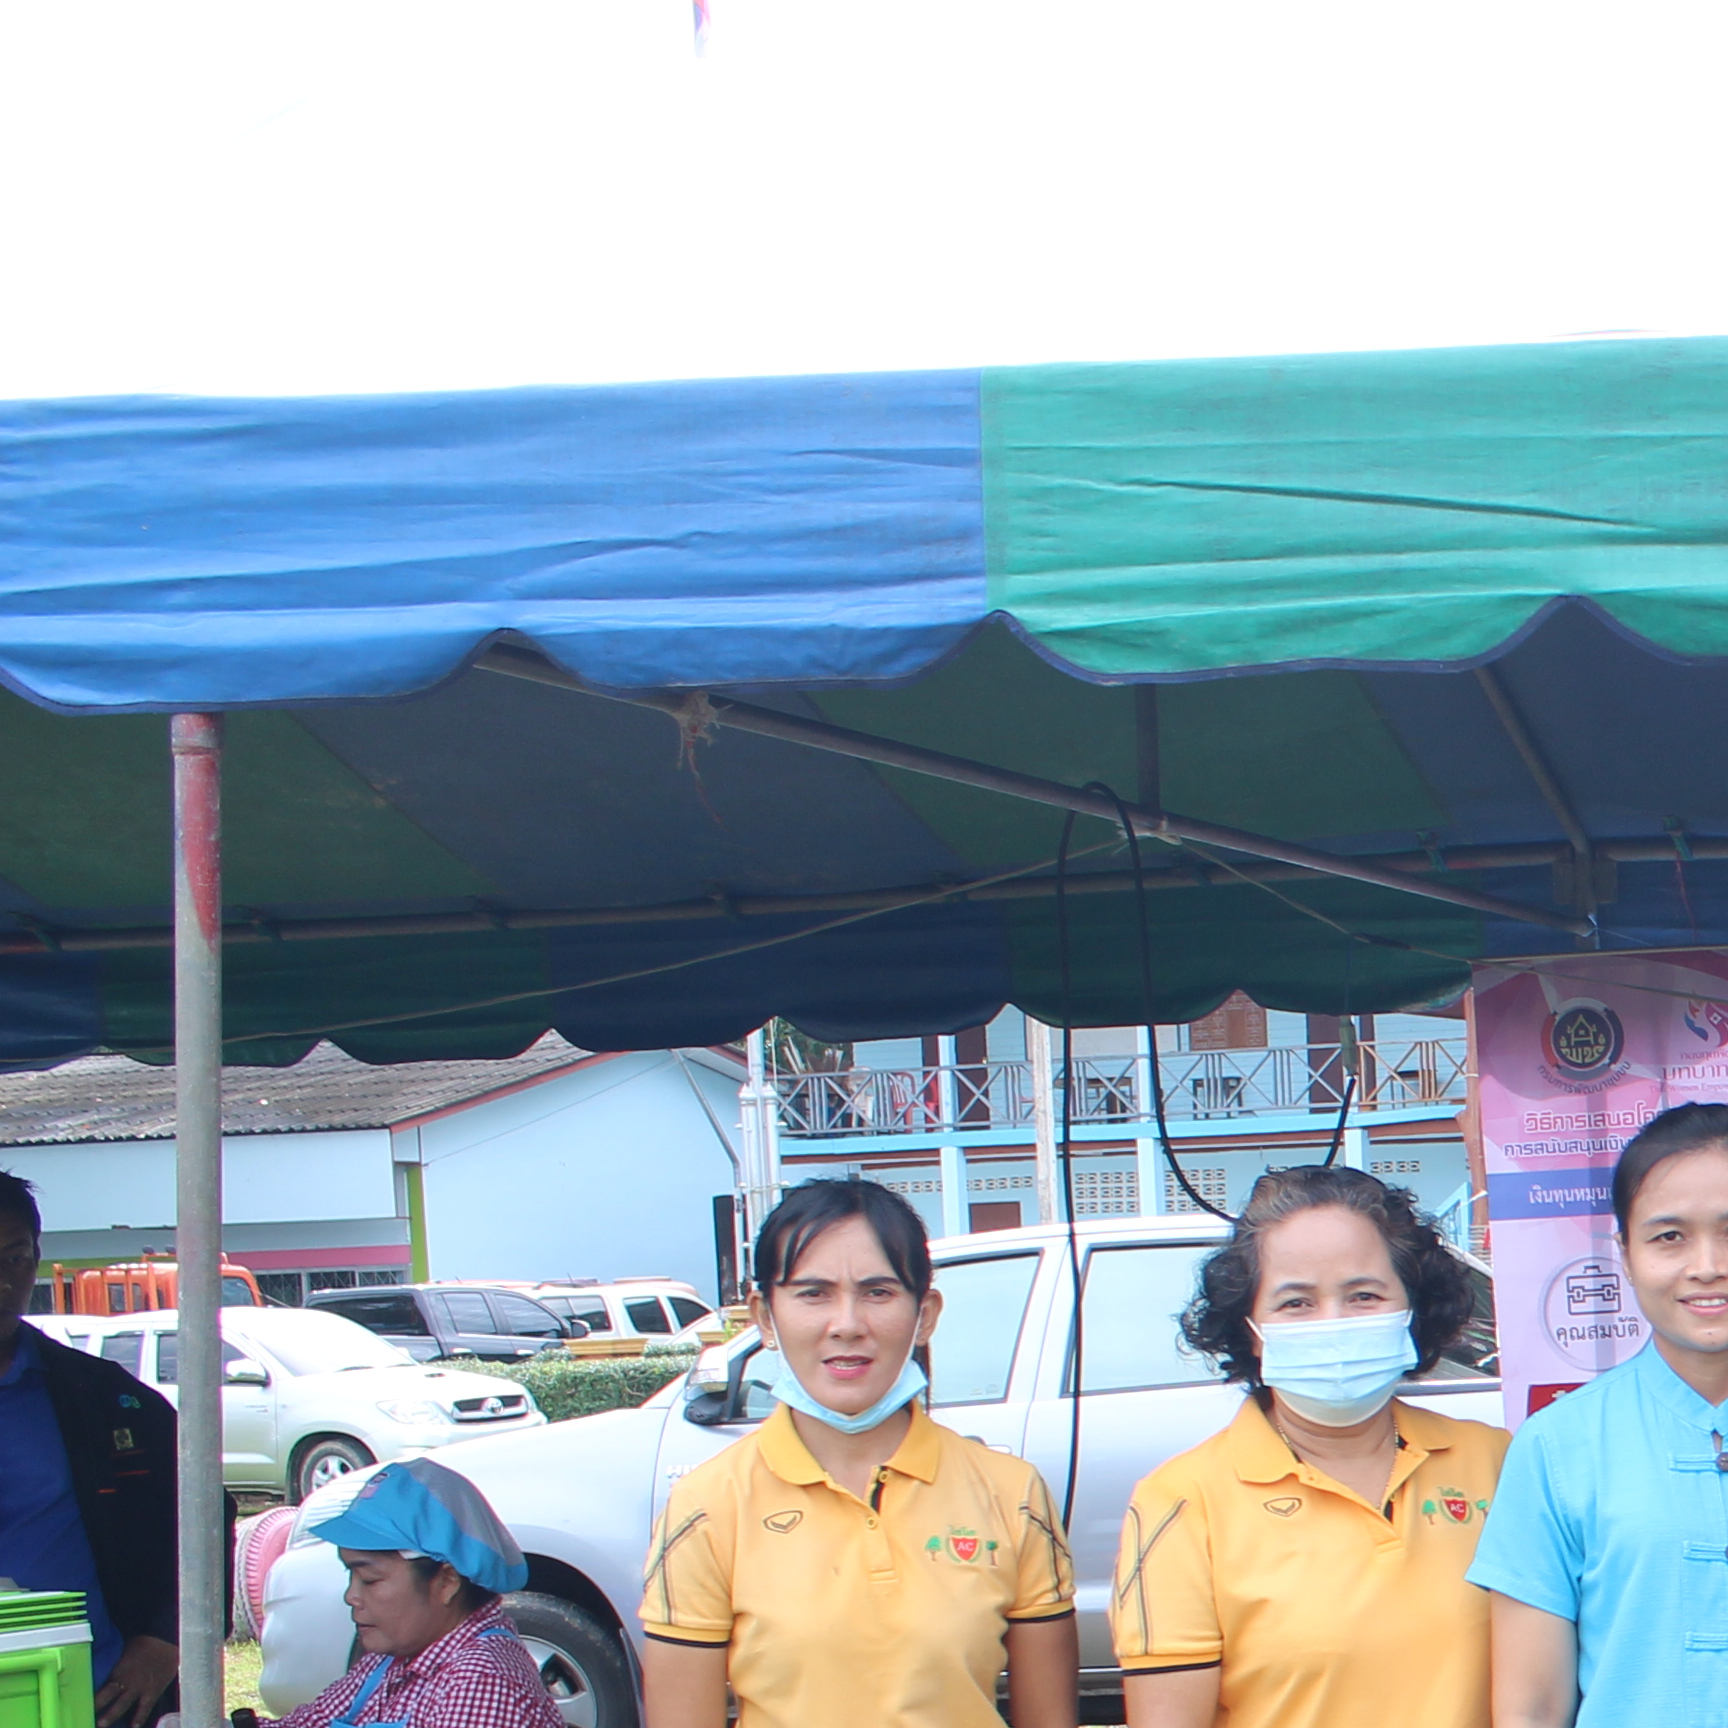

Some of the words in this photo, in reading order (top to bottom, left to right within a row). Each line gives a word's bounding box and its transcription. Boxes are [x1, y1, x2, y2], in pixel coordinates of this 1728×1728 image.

[1556, 1317, 1640, 1349] คุณสมบัติ
[957, 1541, 975, 1552] AC
